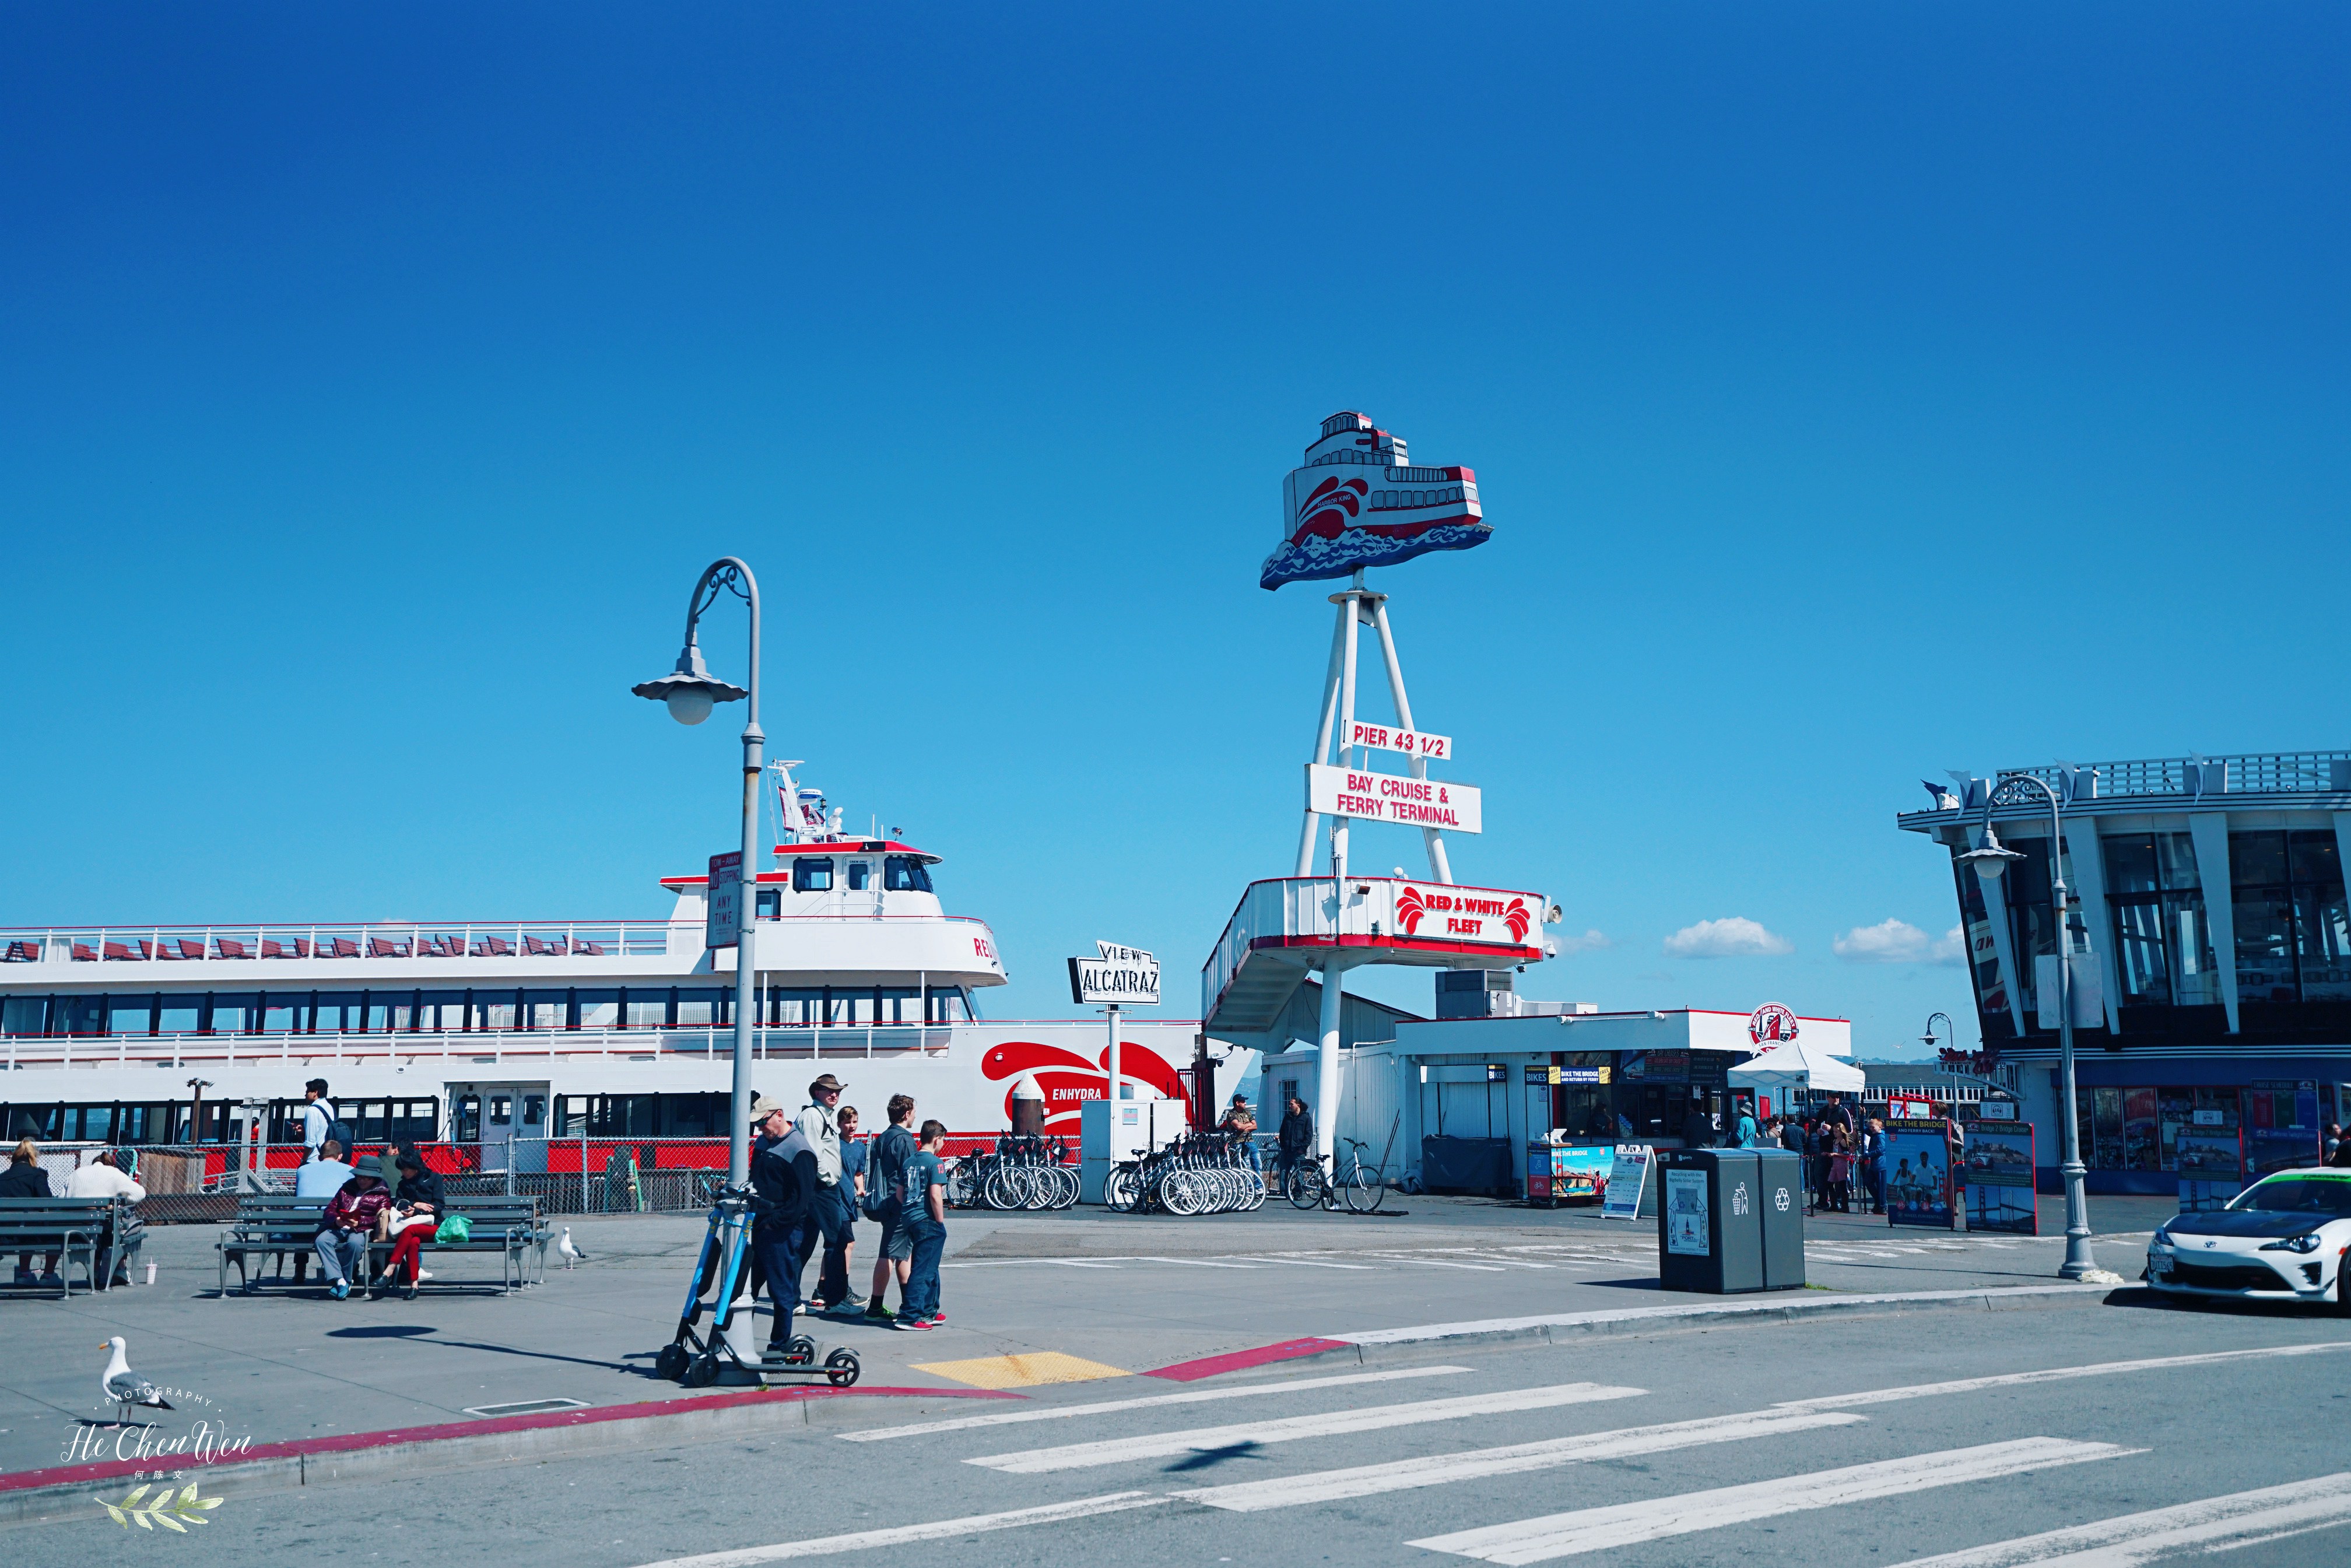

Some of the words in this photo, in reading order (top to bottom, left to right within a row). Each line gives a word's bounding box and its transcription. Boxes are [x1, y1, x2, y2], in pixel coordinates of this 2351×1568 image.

[1318, 497, 1338, 507] HARBOR
[1355, 725, 1388, 746] PIER
[1395, 732, 1414, 750] 43
[1422, 737, 1444, 756] 1/2
[1348, 774, 1374, 792] BAY
[1381, 779, 1432, 801] CRUISE
[1440, 787, 1448, 804] &
[1338, 794, 1384, 816] FERRY
[1390, 801, 1459, 826] TERMINAL
[710, 871, 718, 888] NO
[719, 869, 739, 884] STOPPING
[717, 895, 731, 910] ANY
[1426, 895, 1452, 910] RED
[1454, 897, 1463, 911] &
[1465, 898, 1504, 915] WHITE
[715, 911, 732, 925] TIME
[1448, 918, 1482, 934] FLEET
[1099, 944, 1142, 962] VIEW
[1083, 969, 1159, 992] ALCATRAZ
[1773, 1006, 1785, 1015] WHITE
[1785, 1012, 1795, 1027] FLEET
[1526, 1074, 1547, 1082] BIKES
[1548, 1067, 1559, 1075] FREE
[1052, 1088, 1101, 1100] ENHYDRA
[937, 1163, 944, 1174] 13
[743, 1219, 753, 1238] skip
